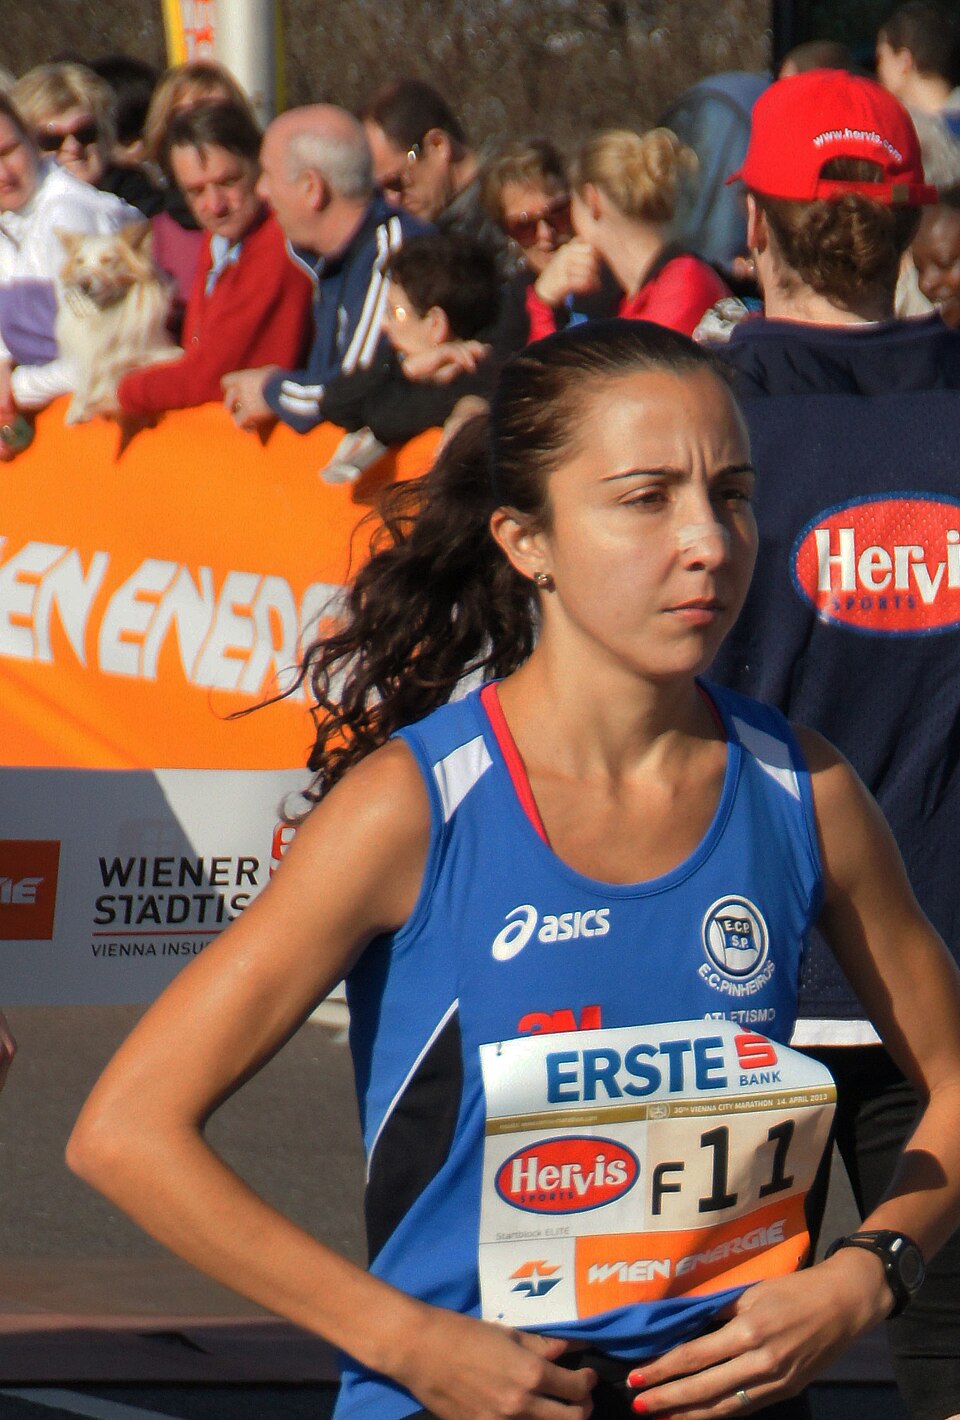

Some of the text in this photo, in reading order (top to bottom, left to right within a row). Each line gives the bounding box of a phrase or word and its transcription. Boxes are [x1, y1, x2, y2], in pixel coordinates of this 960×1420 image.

[0, 535, 110, 668] EN
[832, 595, 917, 611] SPORTS
[99, 856, 260, 887] WIENER
[538, 908, 611, 943] asics
[91, 942, 211, 957] VIENNA INSU
[546, 1035, 728, 1104] ERSTE
[739, 1070, 782, 1087] BANK
[690, 1105, 717, 1113] VIENNA
[718, 1103, 734, 1111] CITY
[735, 1100, 773, 1110] MARATHON
[788, 1096, 809, 1104] APRIL
[810, 1093, 828, 1102] 2013
[510, 1154, 628, 1196] Hervis
[520, 1190, 574, 1203] SPORTS
[545, 1226, 569, 1237] ELITE
[587, 1218, 788, 1284] WIEN ENERGIE
